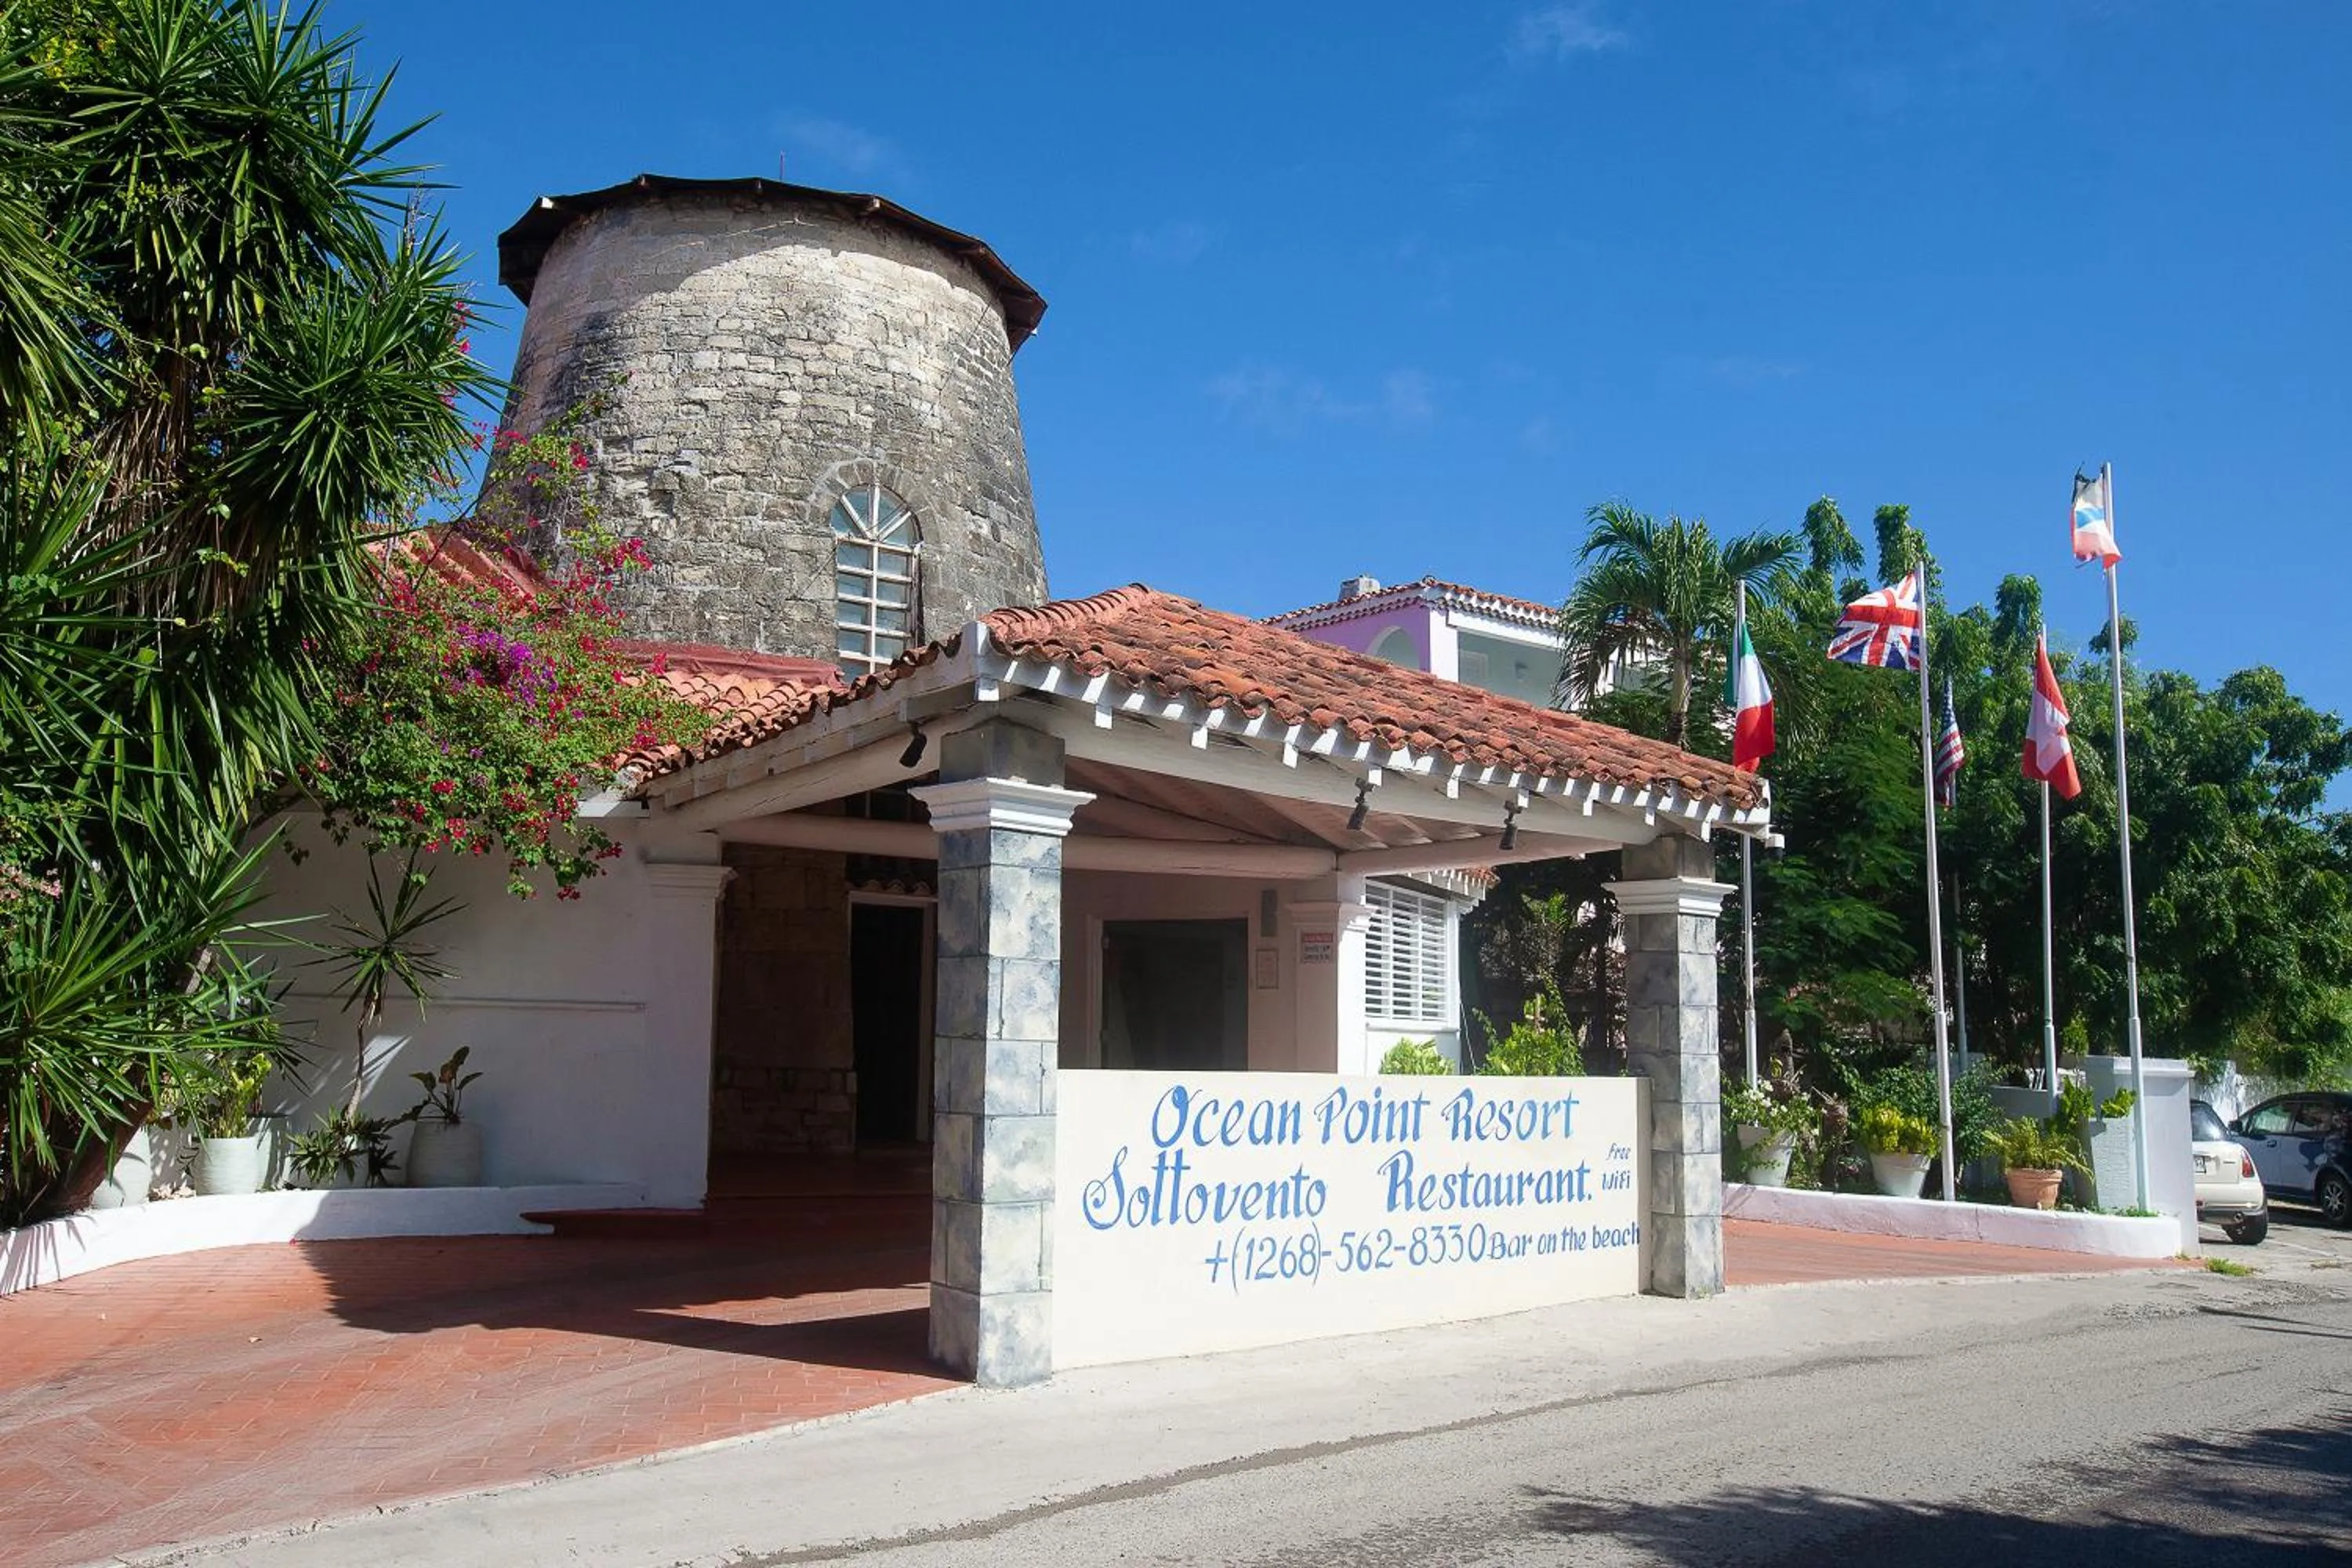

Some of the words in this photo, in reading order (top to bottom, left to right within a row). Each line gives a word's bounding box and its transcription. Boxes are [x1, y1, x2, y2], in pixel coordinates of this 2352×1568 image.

[1152, 1084, 1302, 1148] Ocean
[1313, 1086, 1431, 1145] Point
[1441, 1087, 1580, 1142] Resort
[1083, 1145, 1328, 1230] Sottovento
[1377, 1149, 1592, 1213] Restaurant.
[1487, 1232, 1533, 1260] Bar
[1537, 1232, 1557, 1255] on
[1562, 1225, 1586, 1252] the
[1592, 1221, 1640, 1249] beach
